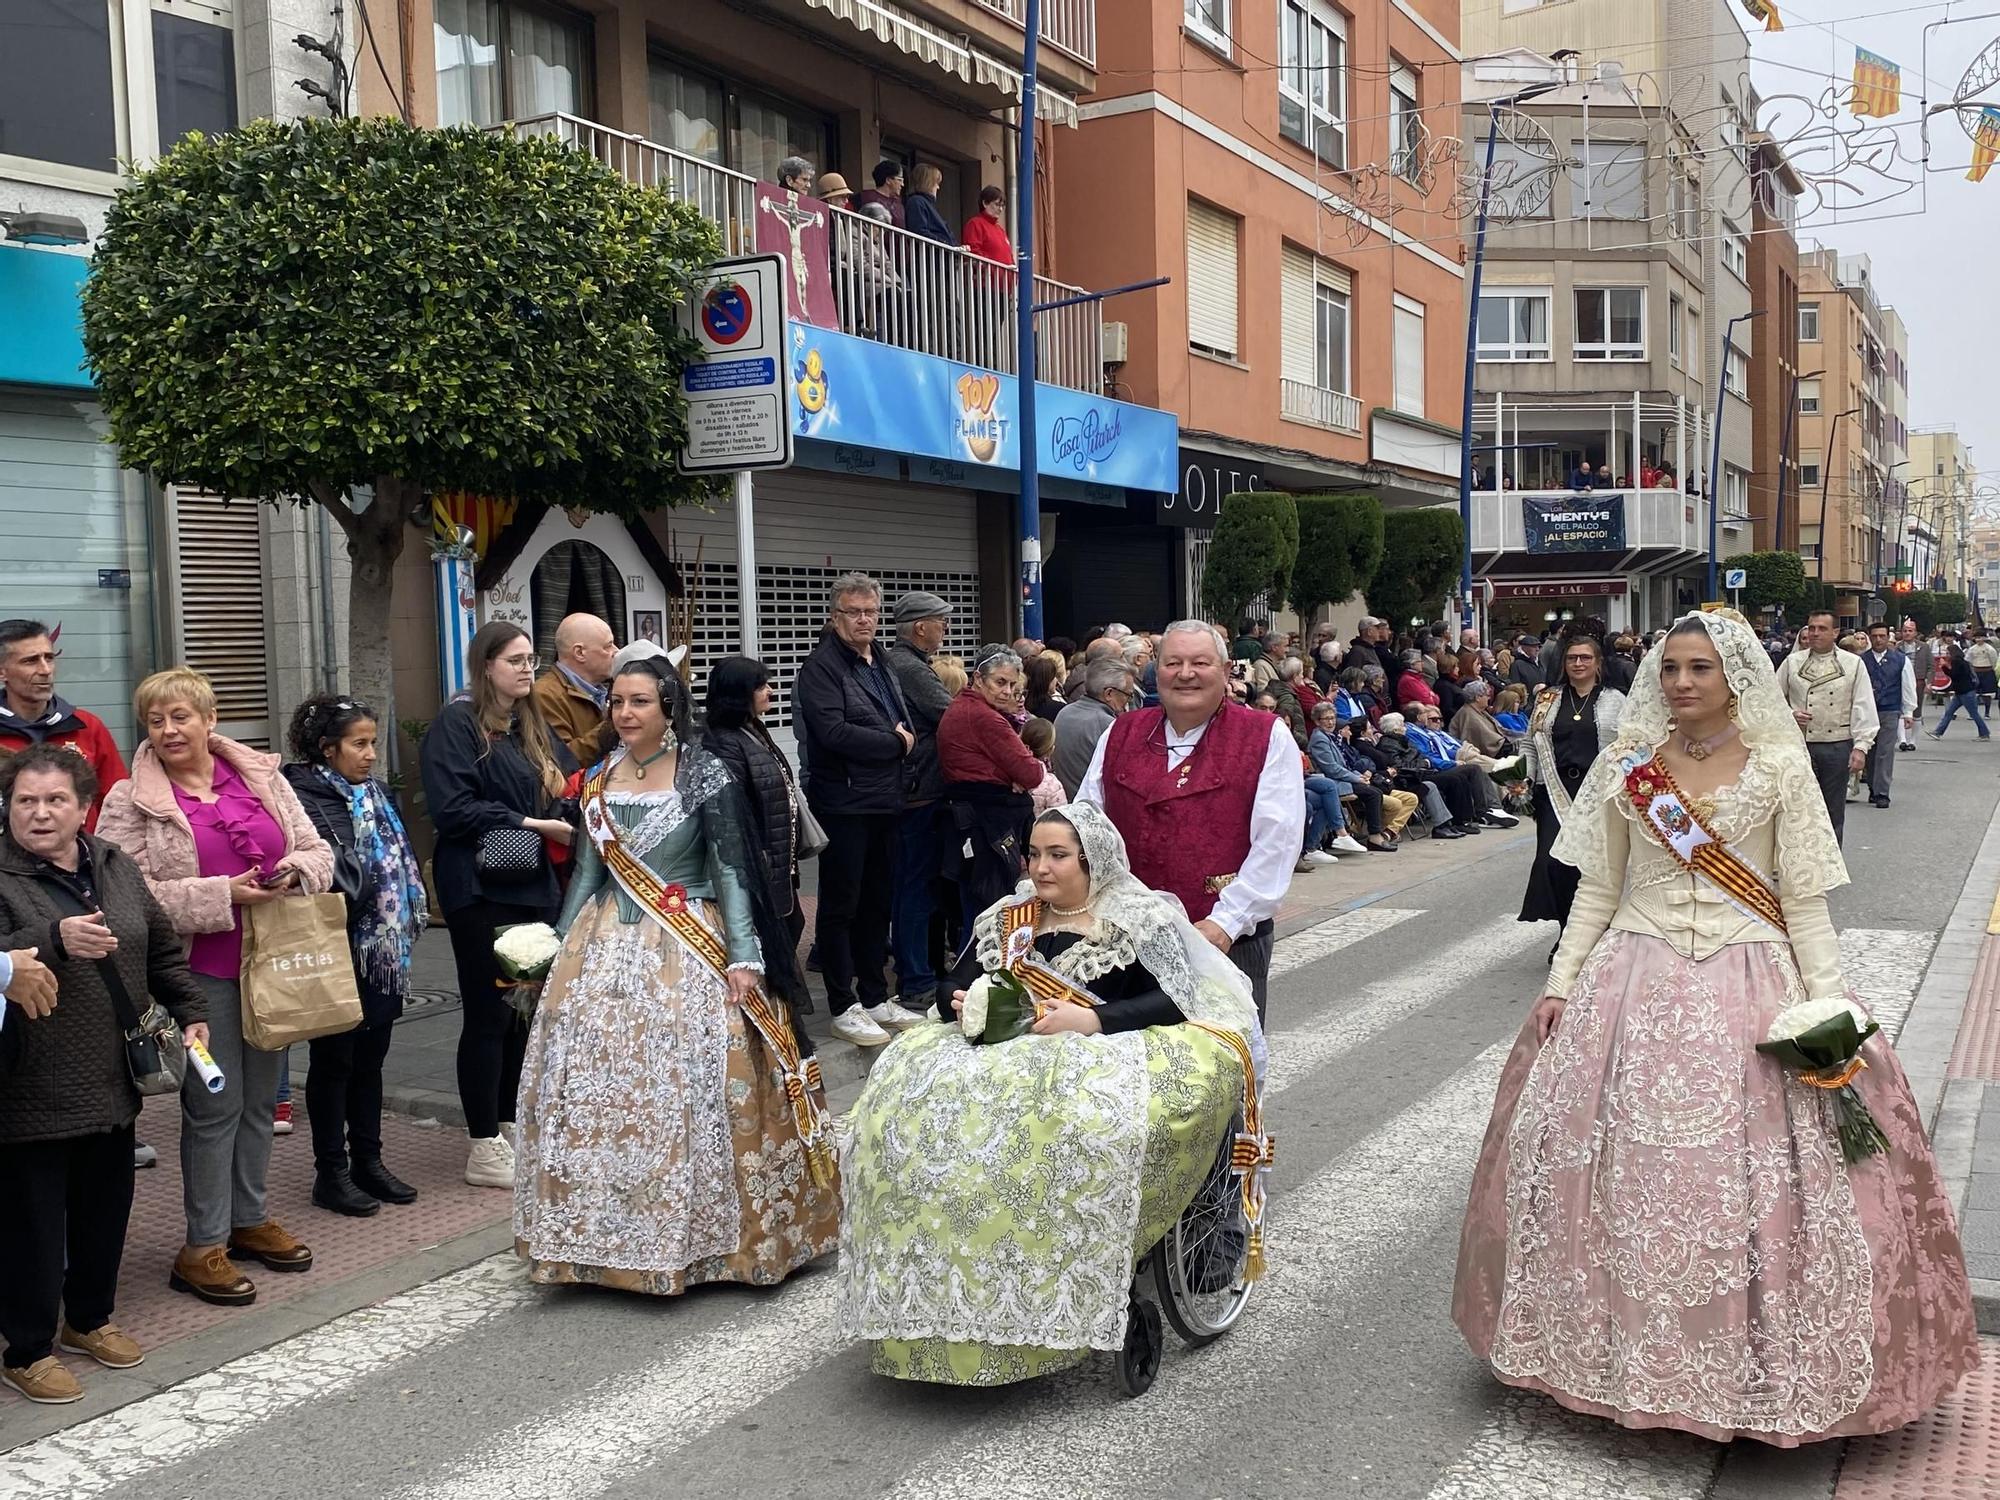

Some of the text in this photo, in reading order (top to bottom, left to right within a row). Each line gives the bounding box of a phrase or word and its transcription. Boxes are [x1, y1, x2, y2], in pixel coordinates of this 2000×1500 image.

[957, 371, 1000, 415] TOY
[954, 418, 1009, 442] PLANET
[1052, 407, 1121, 472] Casa Pitarch
[1563, 530, 1608, 541] ESPACIO!
[1572, 522, 1599, 530] PALCO
[1560, 585, 1585, 595] BAR
[271, 950, 334, 972] lefties
